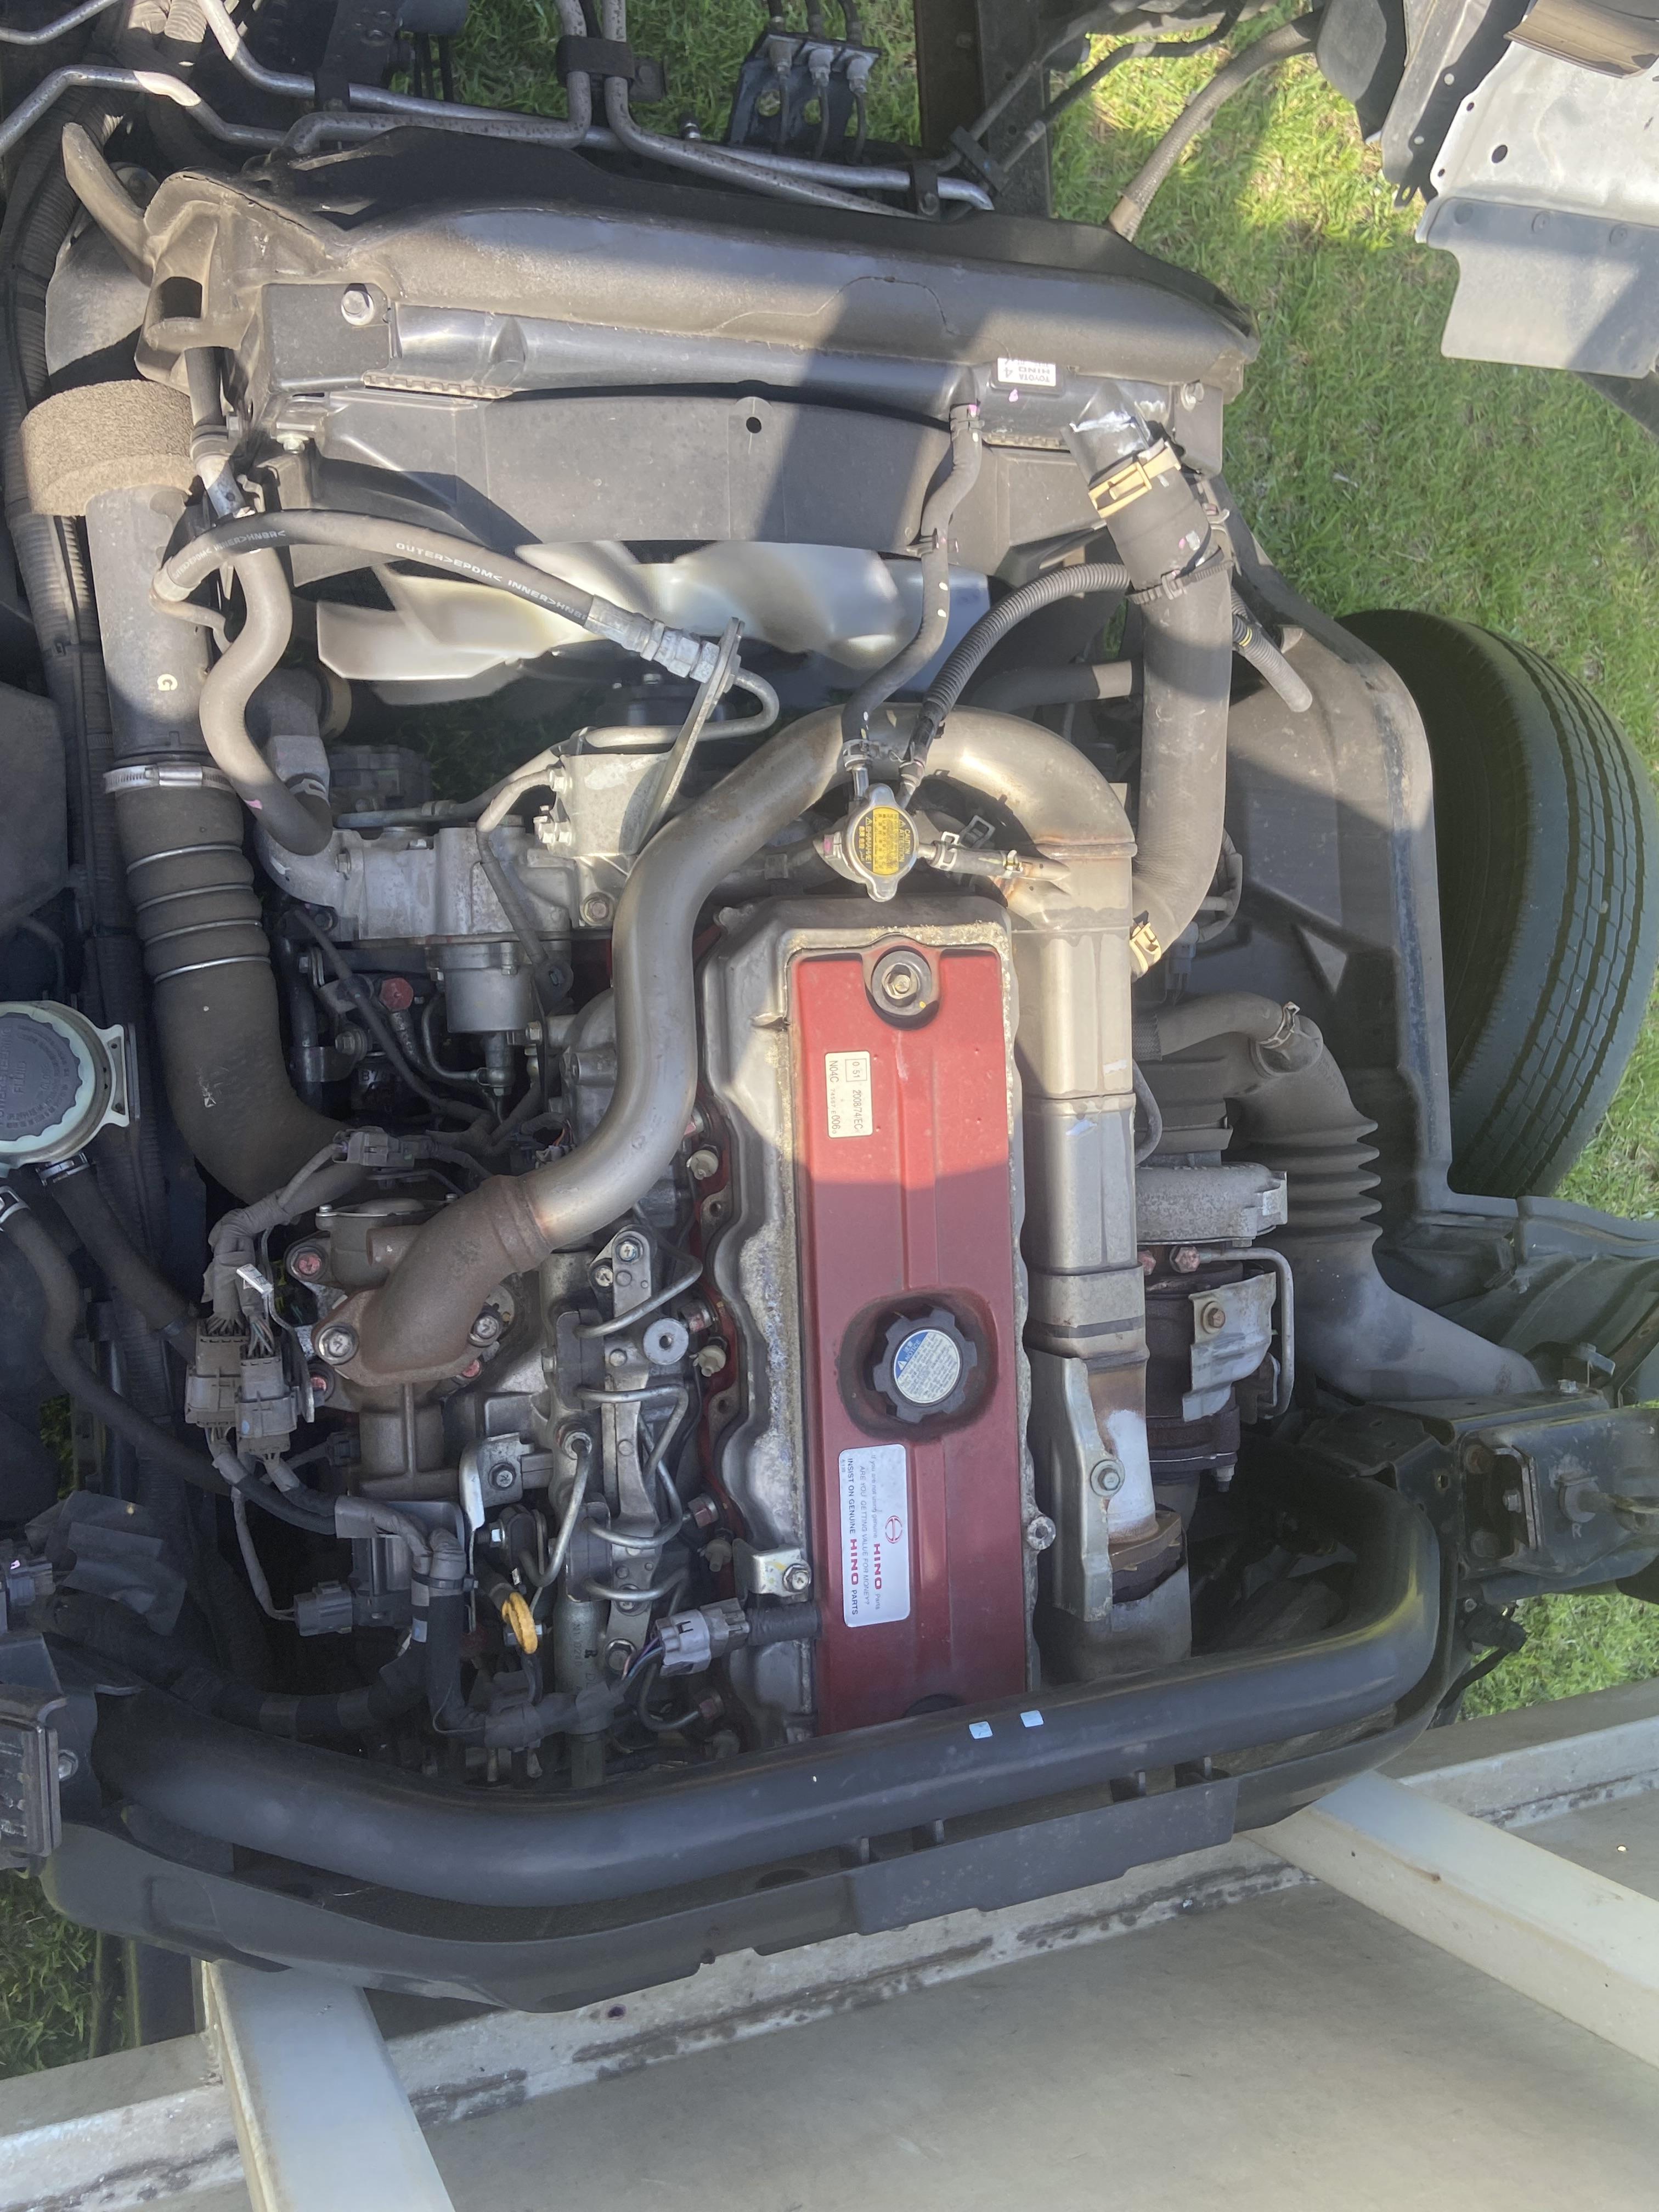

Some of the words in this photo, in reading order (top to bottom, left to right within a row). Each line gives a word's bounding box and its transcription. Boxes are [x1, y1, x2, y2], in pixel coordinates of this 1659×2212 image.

[1019, 374, 1050, 382] TOYOTA
[829, 1060, 839, 1083] N04C
[853, 1090, 864, 1130] 2008/74/EC
[848, 1485, 855, 1497] ON
[850, 1539, 859, 1585] HINO
[873, 1543, 882, 1589] HINO
